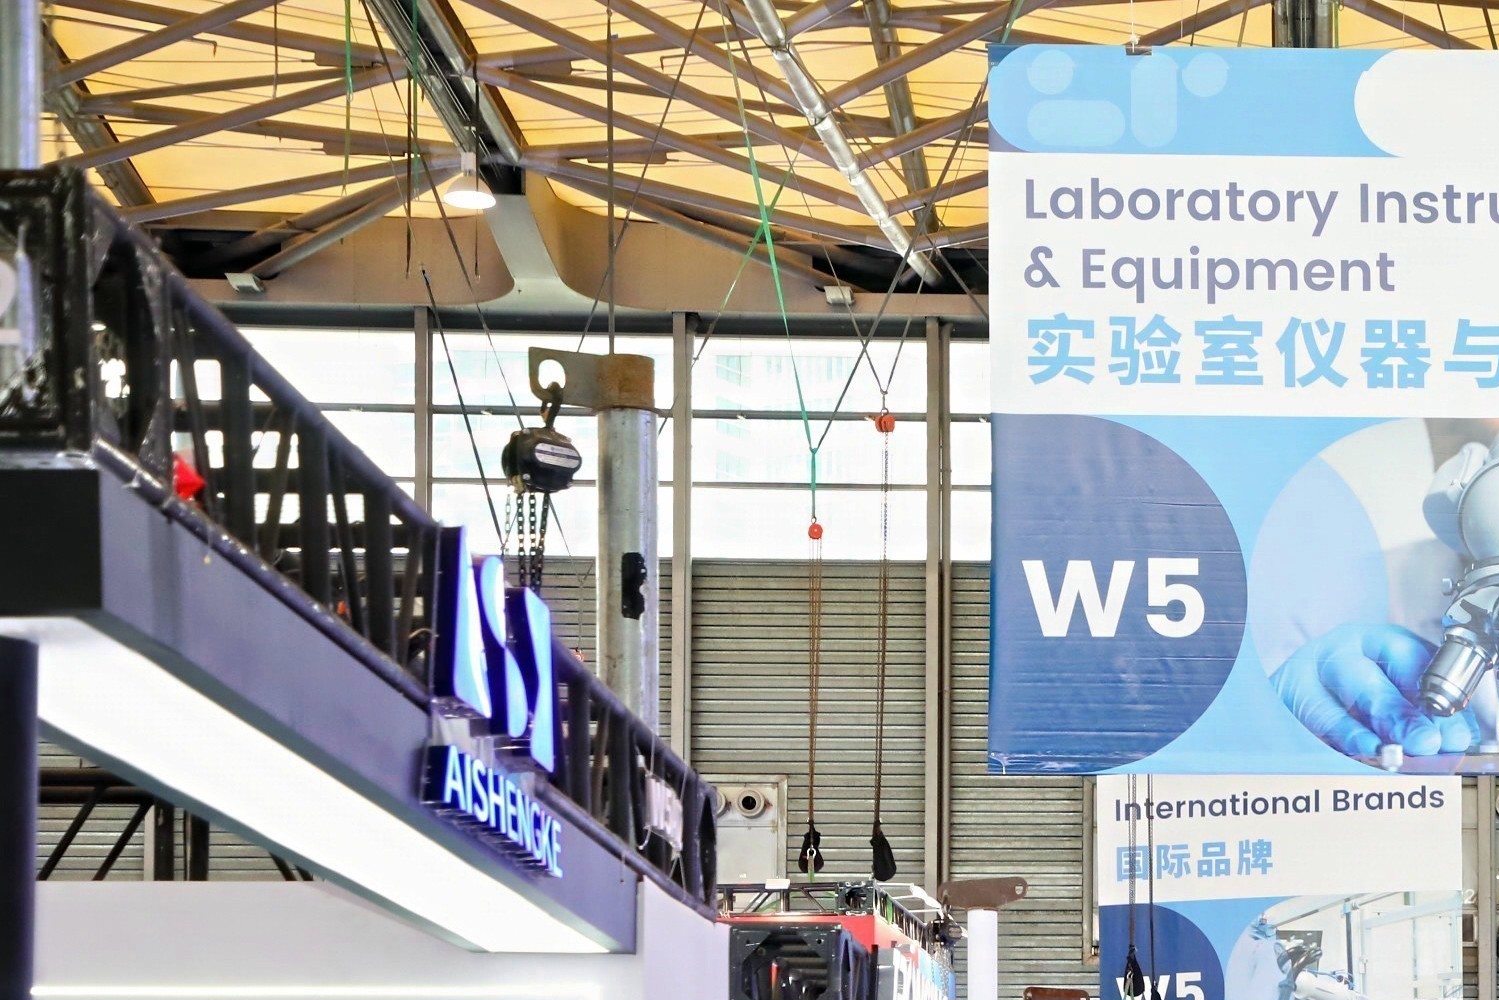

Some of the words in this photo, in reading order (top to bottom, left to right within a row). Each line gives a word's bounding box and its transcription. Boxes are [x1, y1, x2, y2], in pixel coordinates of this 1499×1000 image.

[1024, 179, 1338, 236] Laboratory
[1024, 246, 1060, 289] &
[1081, 246, 1396, 304] Equipment
[1022, 558, 1207, 638] W5
[443, 744, 564, 878] AISHENGKE
[1115, 789, 1320, 822] International
[1332, 786, 1445, 812] Brands
[1116, 838, 1274, 882] 国际品牌
